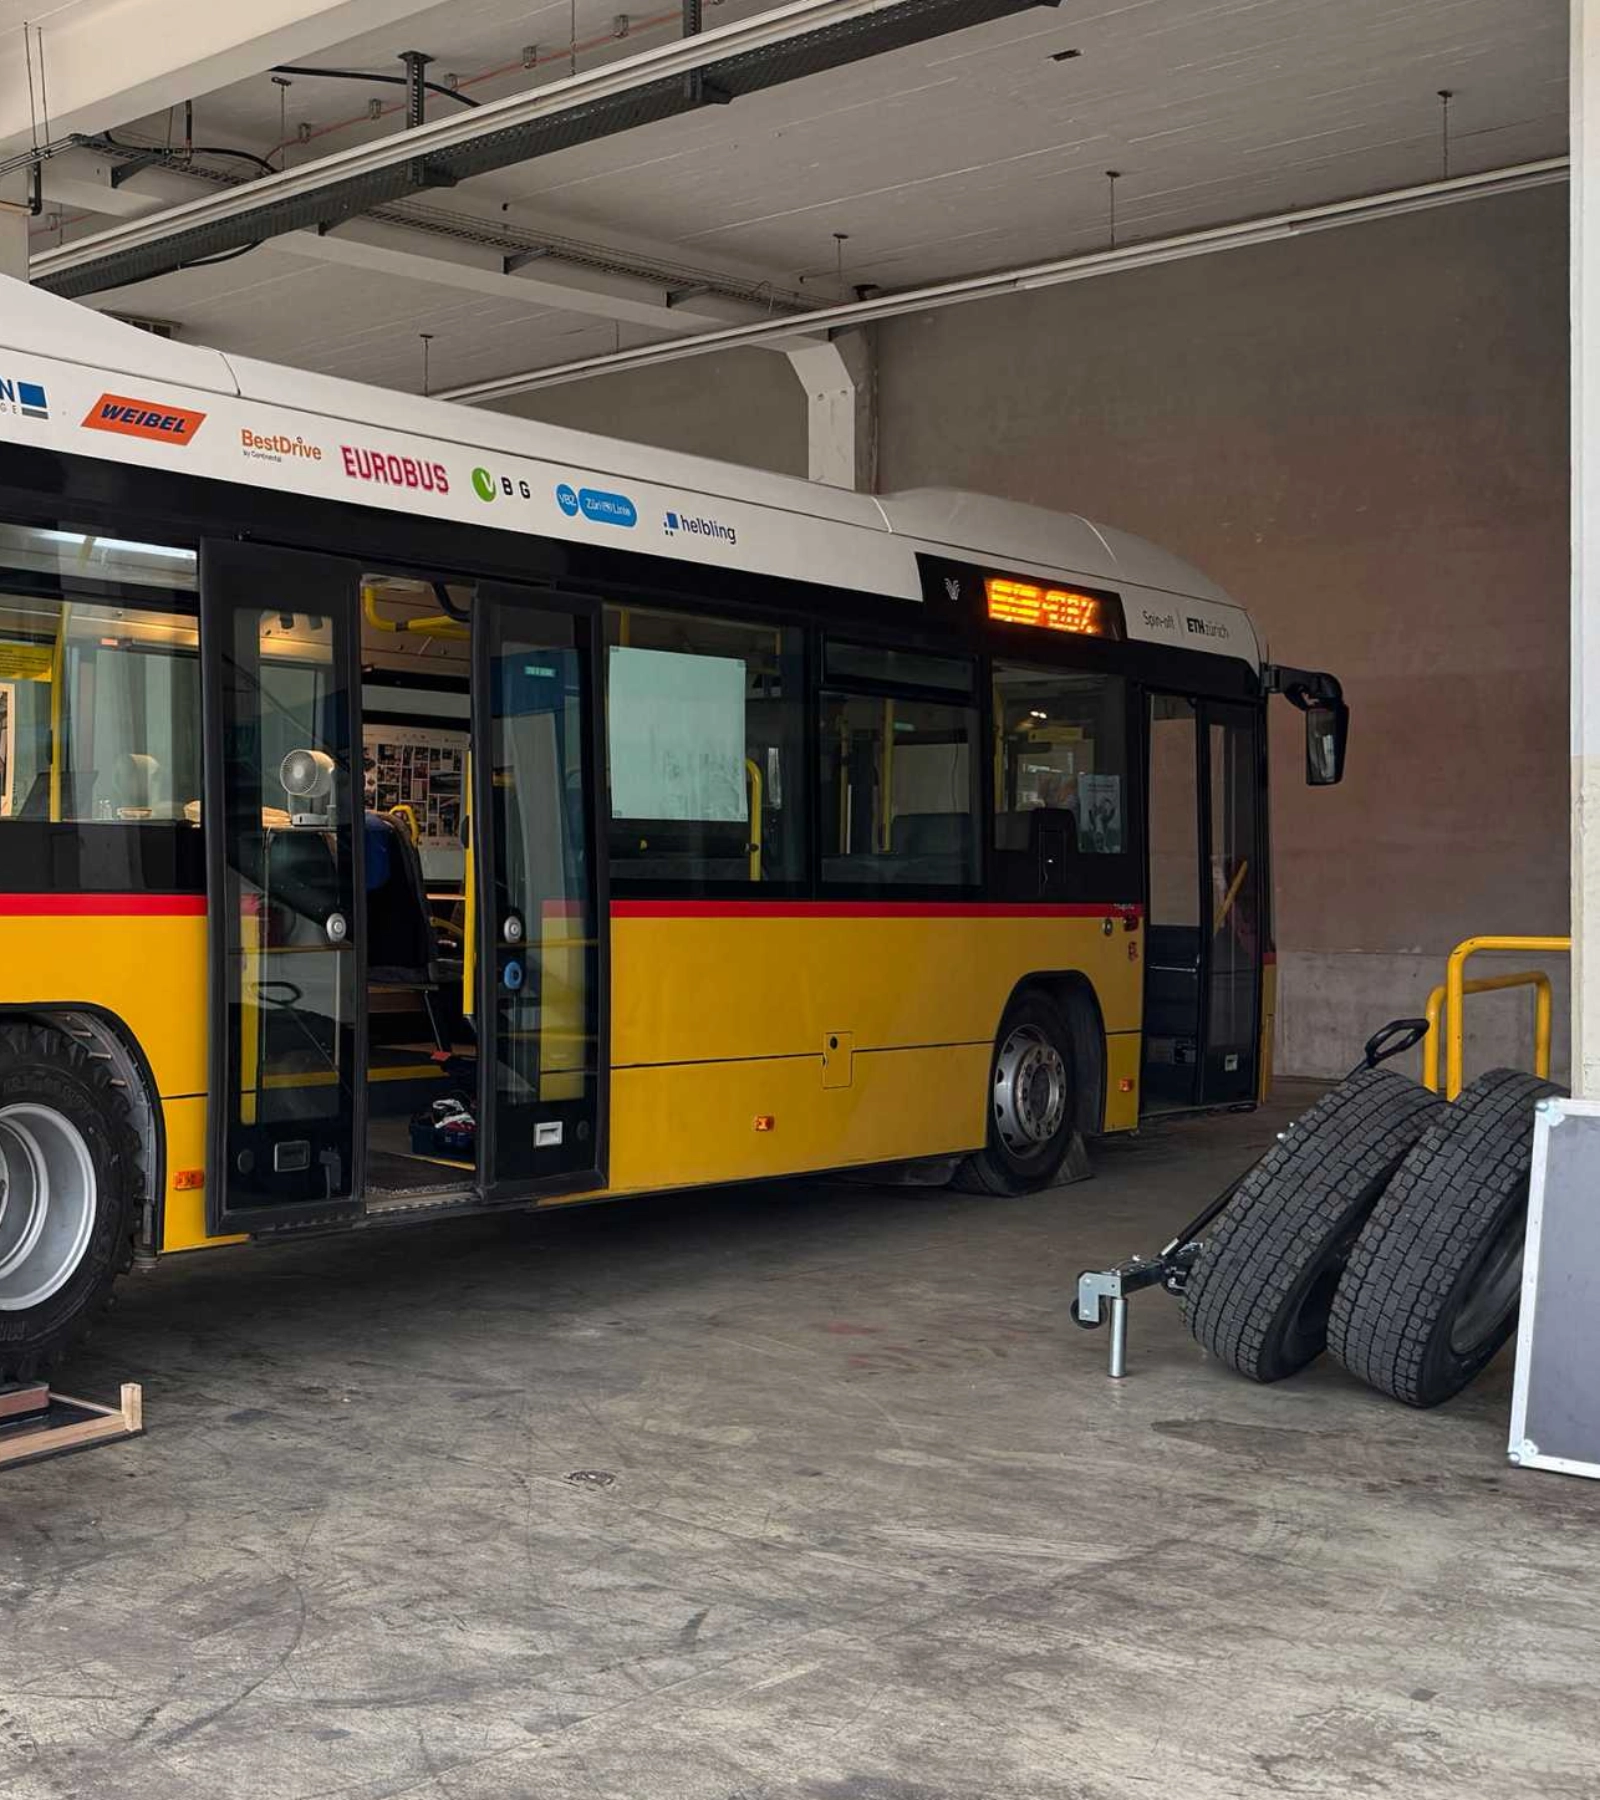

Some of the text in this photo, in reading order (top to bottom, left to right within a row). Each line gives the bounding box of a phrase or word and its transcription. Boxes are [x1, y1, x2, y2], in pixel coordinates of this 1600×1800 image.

[100, 403, 187, 433] WEIBEL
[241, 429, 322, 460] BestDrive
[340, 445, 450, 495] EUROBUS
[558, 493, 577, 506] VBZ
[681, 515, 736, 545] helbling
[1142, 608, 1174, 630] Spin-off
